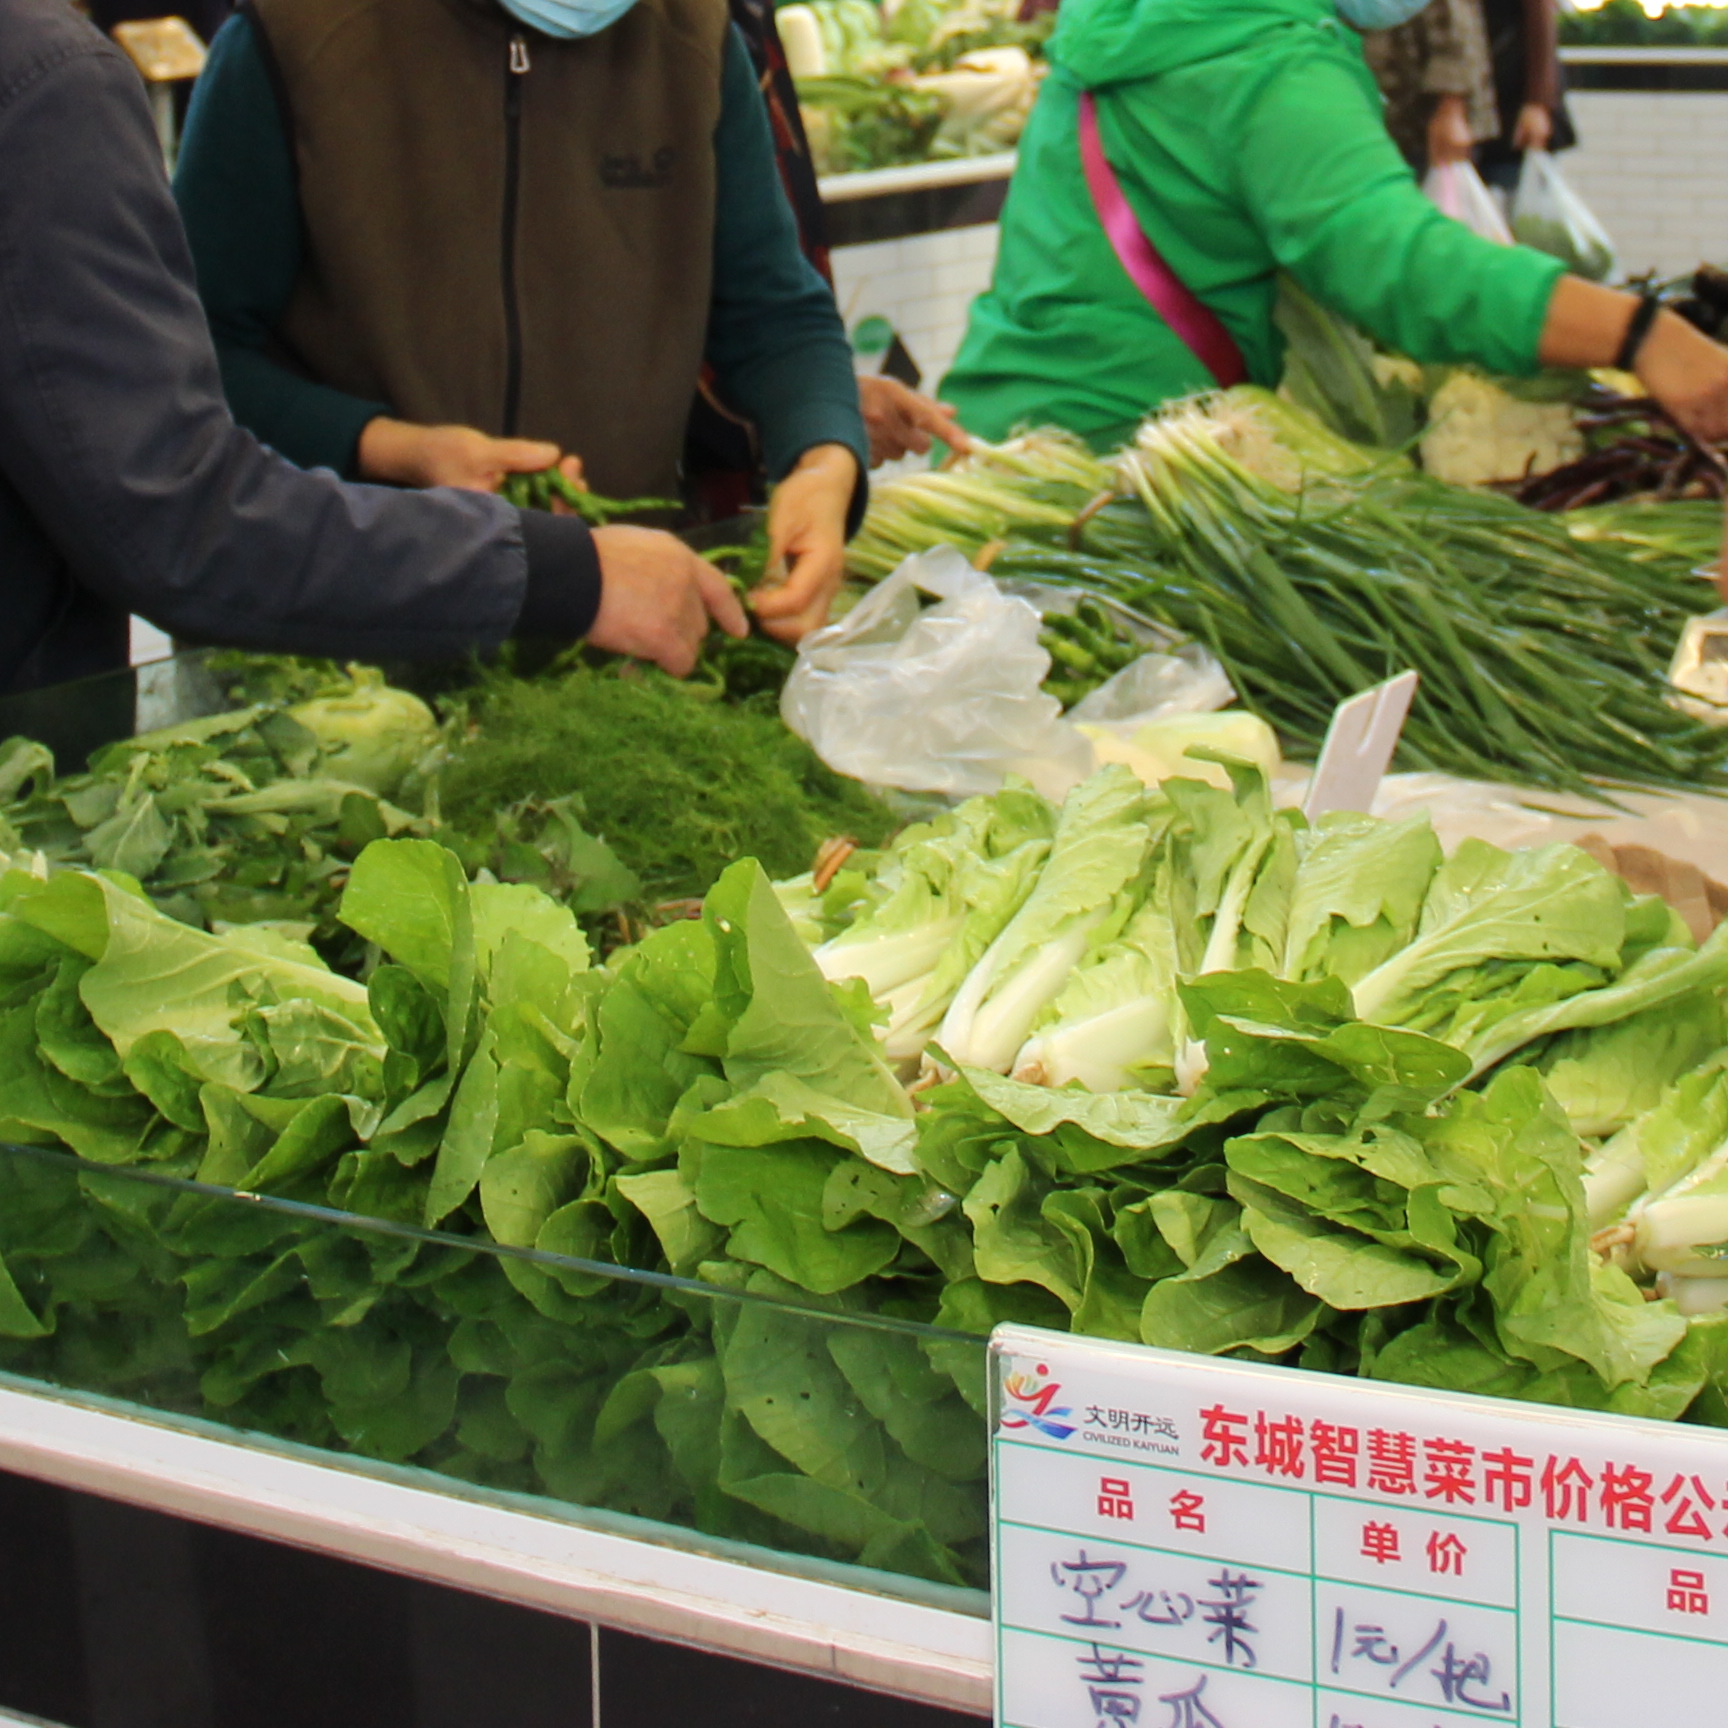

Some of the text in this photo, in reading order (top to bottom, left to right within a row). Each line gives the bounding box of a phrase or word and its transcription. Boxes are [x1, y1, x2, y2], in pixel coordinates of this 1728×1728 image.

[1083, 1404, 1180, 1441] 文明开远
[1083, 1430, 1180, 1457] CIVILIZED KAIYUAN
[1097, 1476, 1206, 1534] 品名
[1360, 1520, 1468, 1576] 单价
[1050, 1549, 1265, 1668] 空心菜
